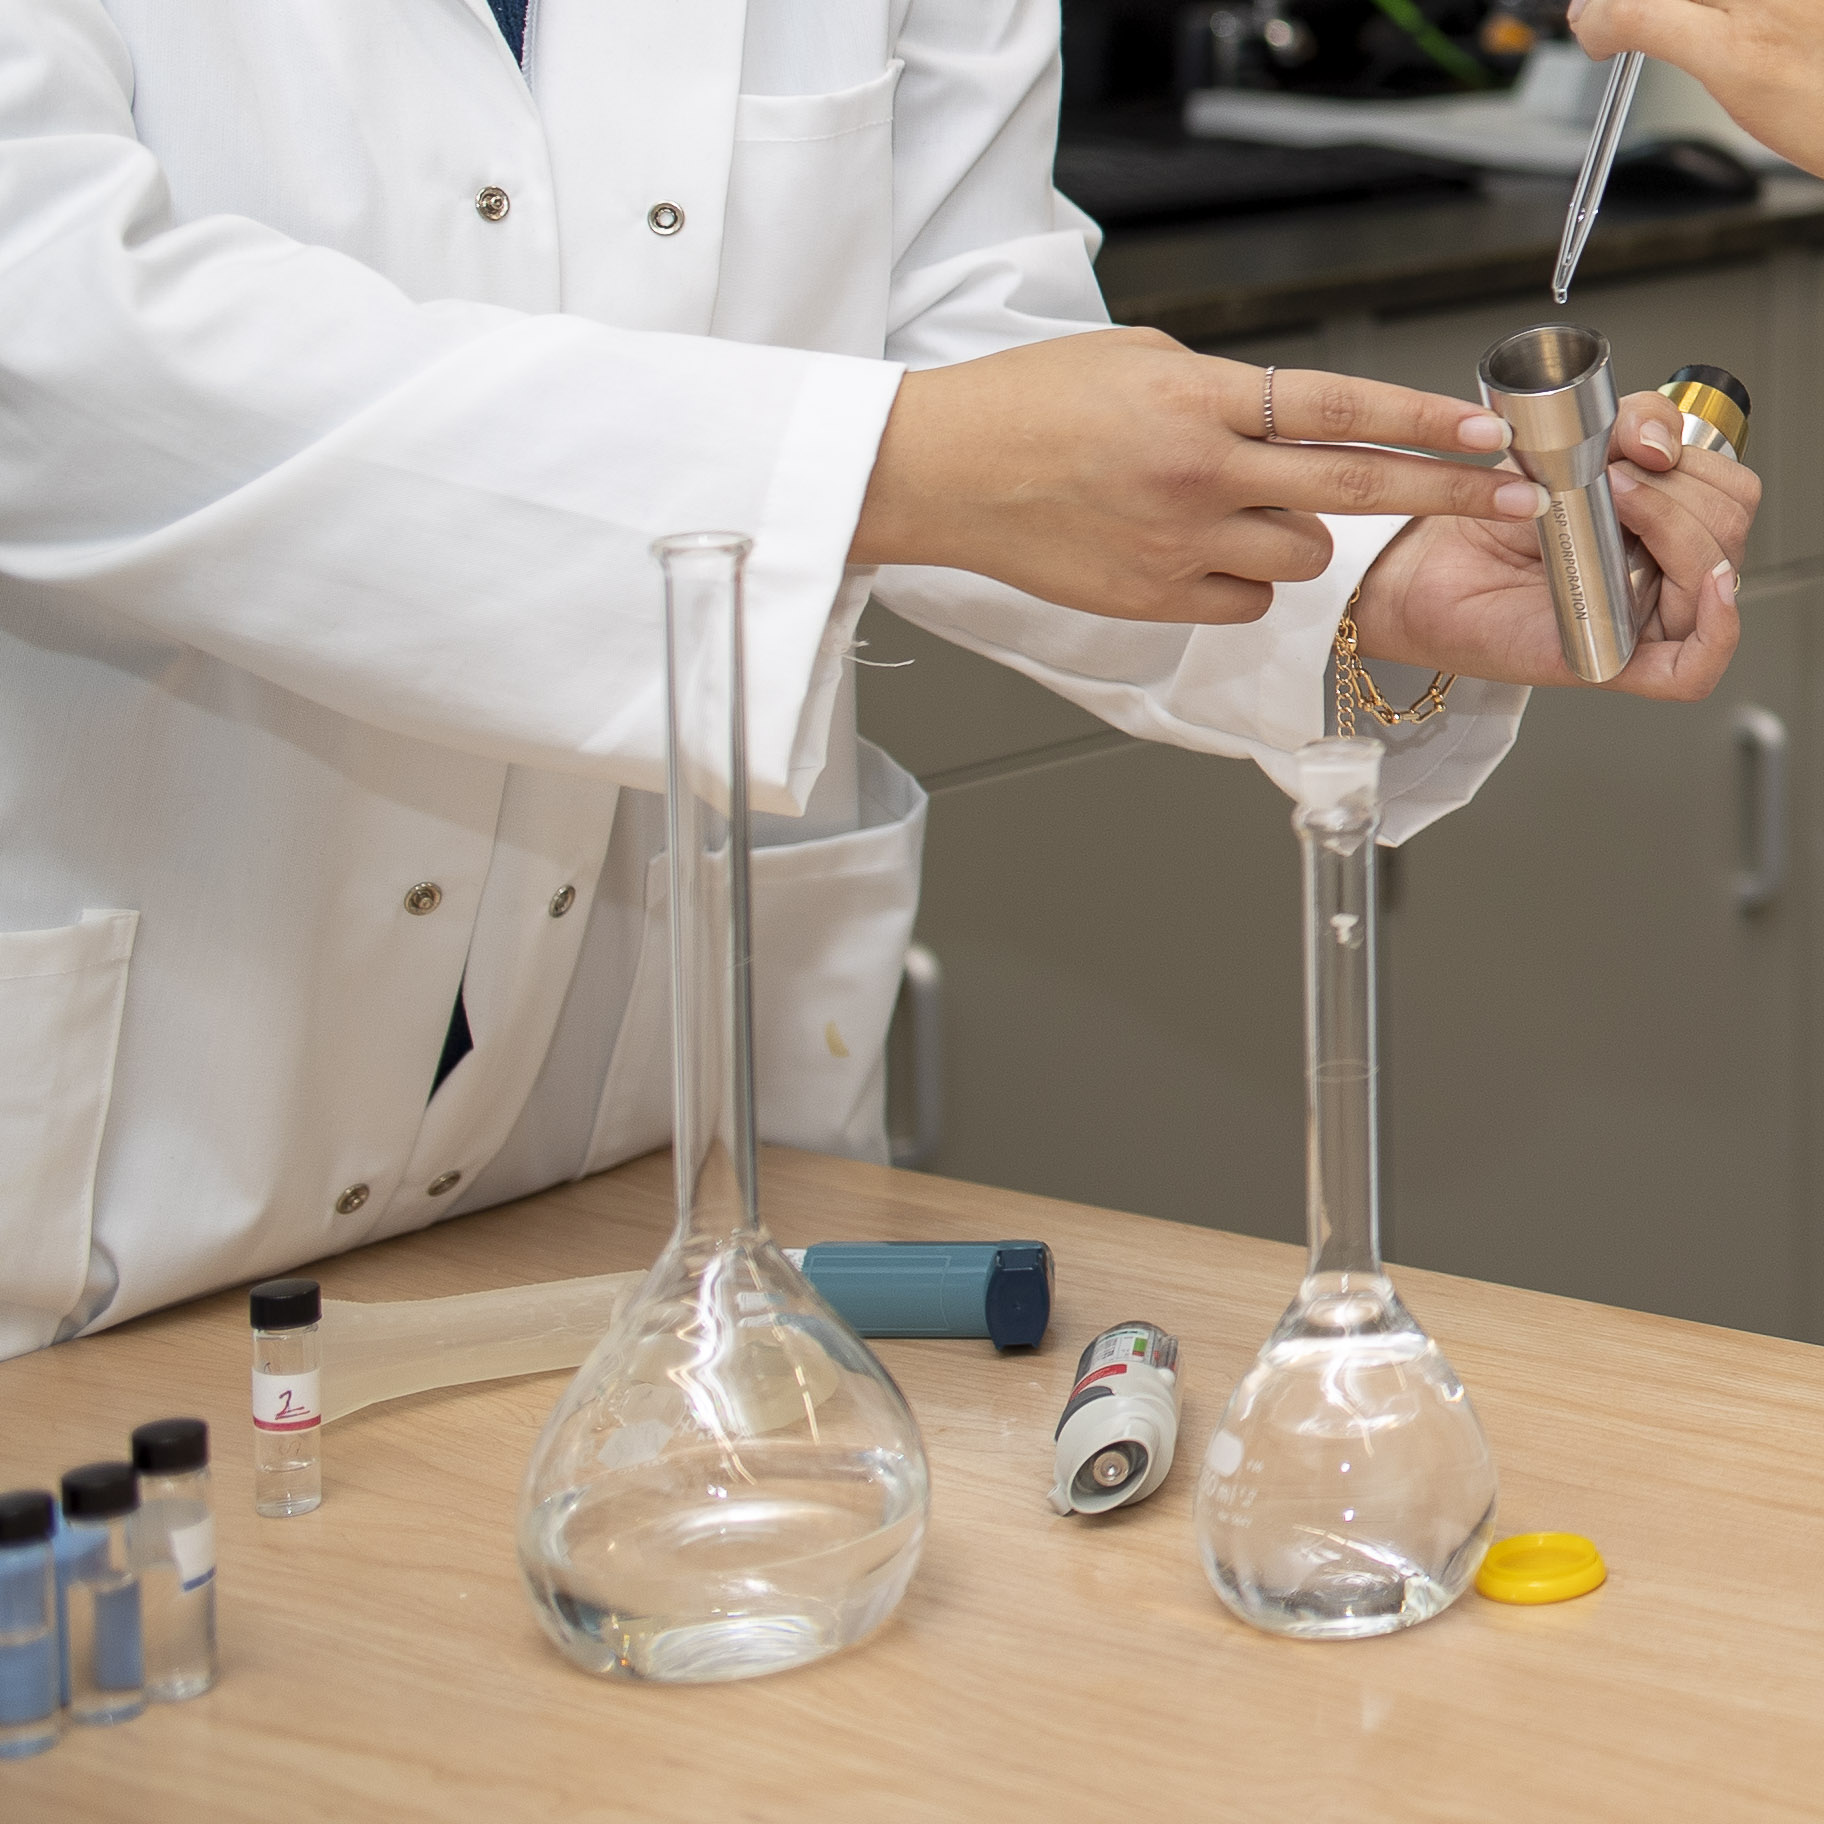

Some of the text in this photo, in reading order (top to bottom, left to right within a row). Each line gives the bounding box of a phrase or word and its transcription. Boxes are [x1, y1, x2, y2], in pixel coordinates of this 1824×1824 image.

[1551, 499, 1589, 621] MSP CORPORATION
[275, 1389, 311, 1420] 2
